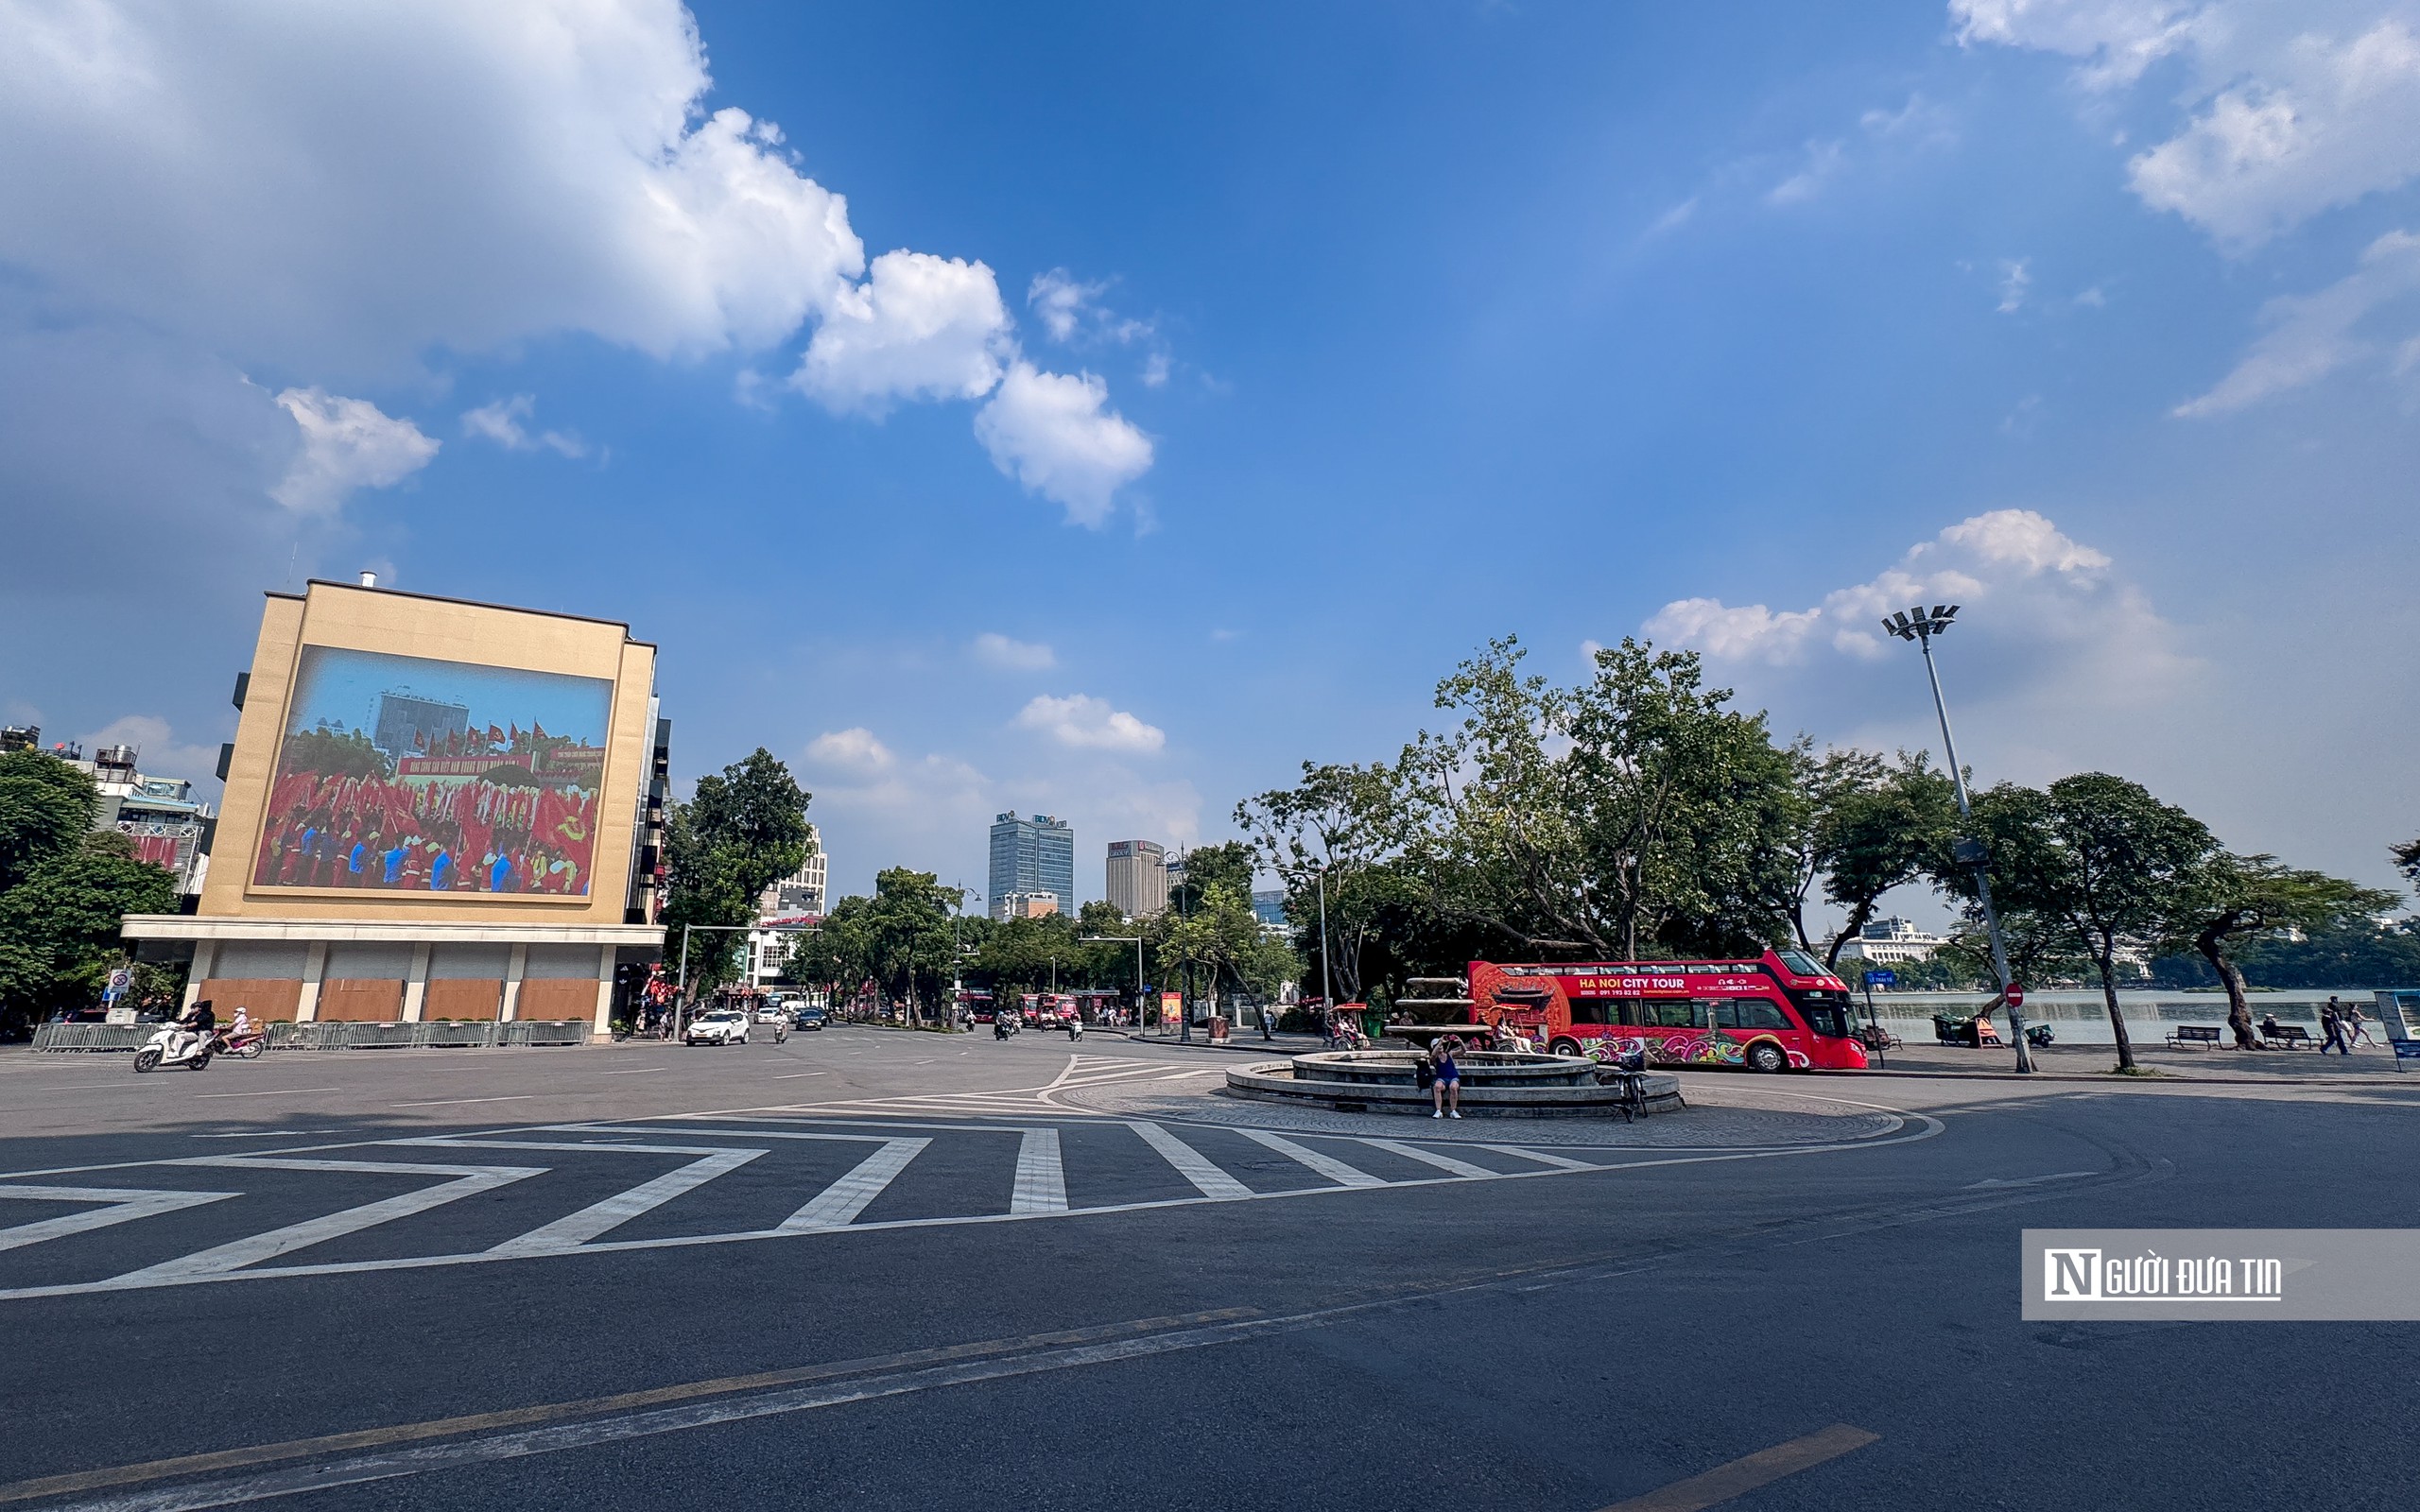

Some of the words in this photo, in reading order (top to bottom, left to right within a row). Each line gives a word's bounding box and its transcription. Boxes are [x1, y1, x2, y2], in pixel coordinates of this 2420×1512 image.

[1580, 978, 1596, 988] HA
[1599, 978, 1620, 988] NOI
[1622, 978, 1649, 988] CITY
[1651, 978, 1685, 988] TOUR
